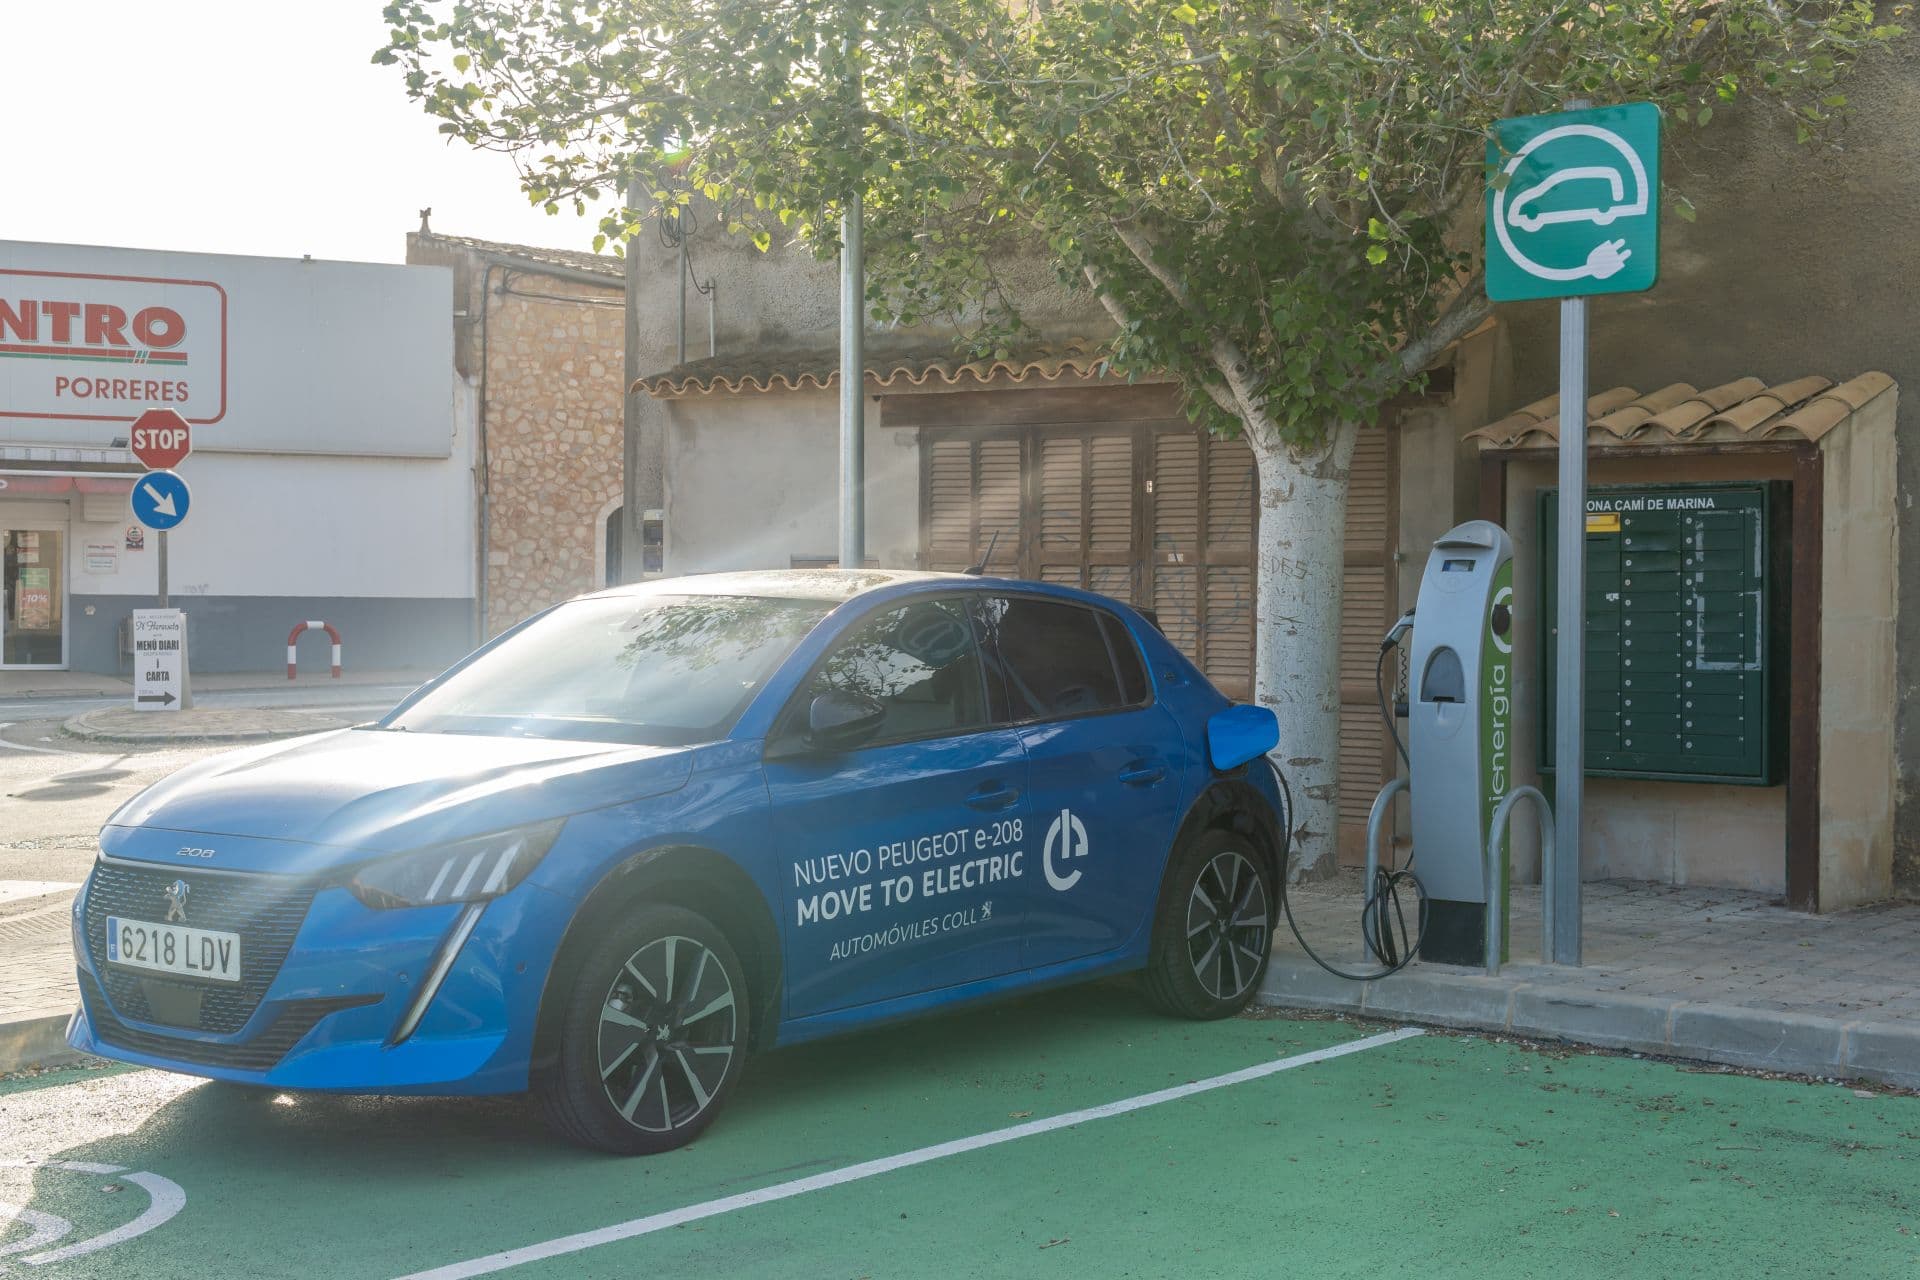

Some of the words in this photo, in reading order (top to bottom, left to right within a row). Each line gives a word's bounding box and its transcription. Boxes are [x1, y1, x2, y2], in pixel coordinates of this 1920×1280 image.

[0, 298, 187, 348] NTRO
[55, 376, 189, 402] PORRERES
[134, 429, 187, 450] STOP
[1586, 500, 1612, 512] ONA
[1614, 496, 1645, 511] CAMÍ
[1647, 499, 1664, 510] DE
[1667, 497, 1715, 510] MARINA
[158, 640, 180, 651] DIARI
[146, 671, 170, 682] CARTA
[176, 847, 215, 858] 208
[794, 849, 871, 887] NUEVO
[879, 828, 969, 870] PEUGEOT
[974, 818, 1023, 849] e-208
[797, 884, 872, 926] MOVE
[880, 875, 913, 906] TO
[922, 851, 1023, 897] ELECTRIC
[830, 917, 938, 961] AUTOMÓVILES
[942, 908, 977, 931] COLL
[122, 926, 176, 966] 6218
[185, 934, 231, 974] LDV
